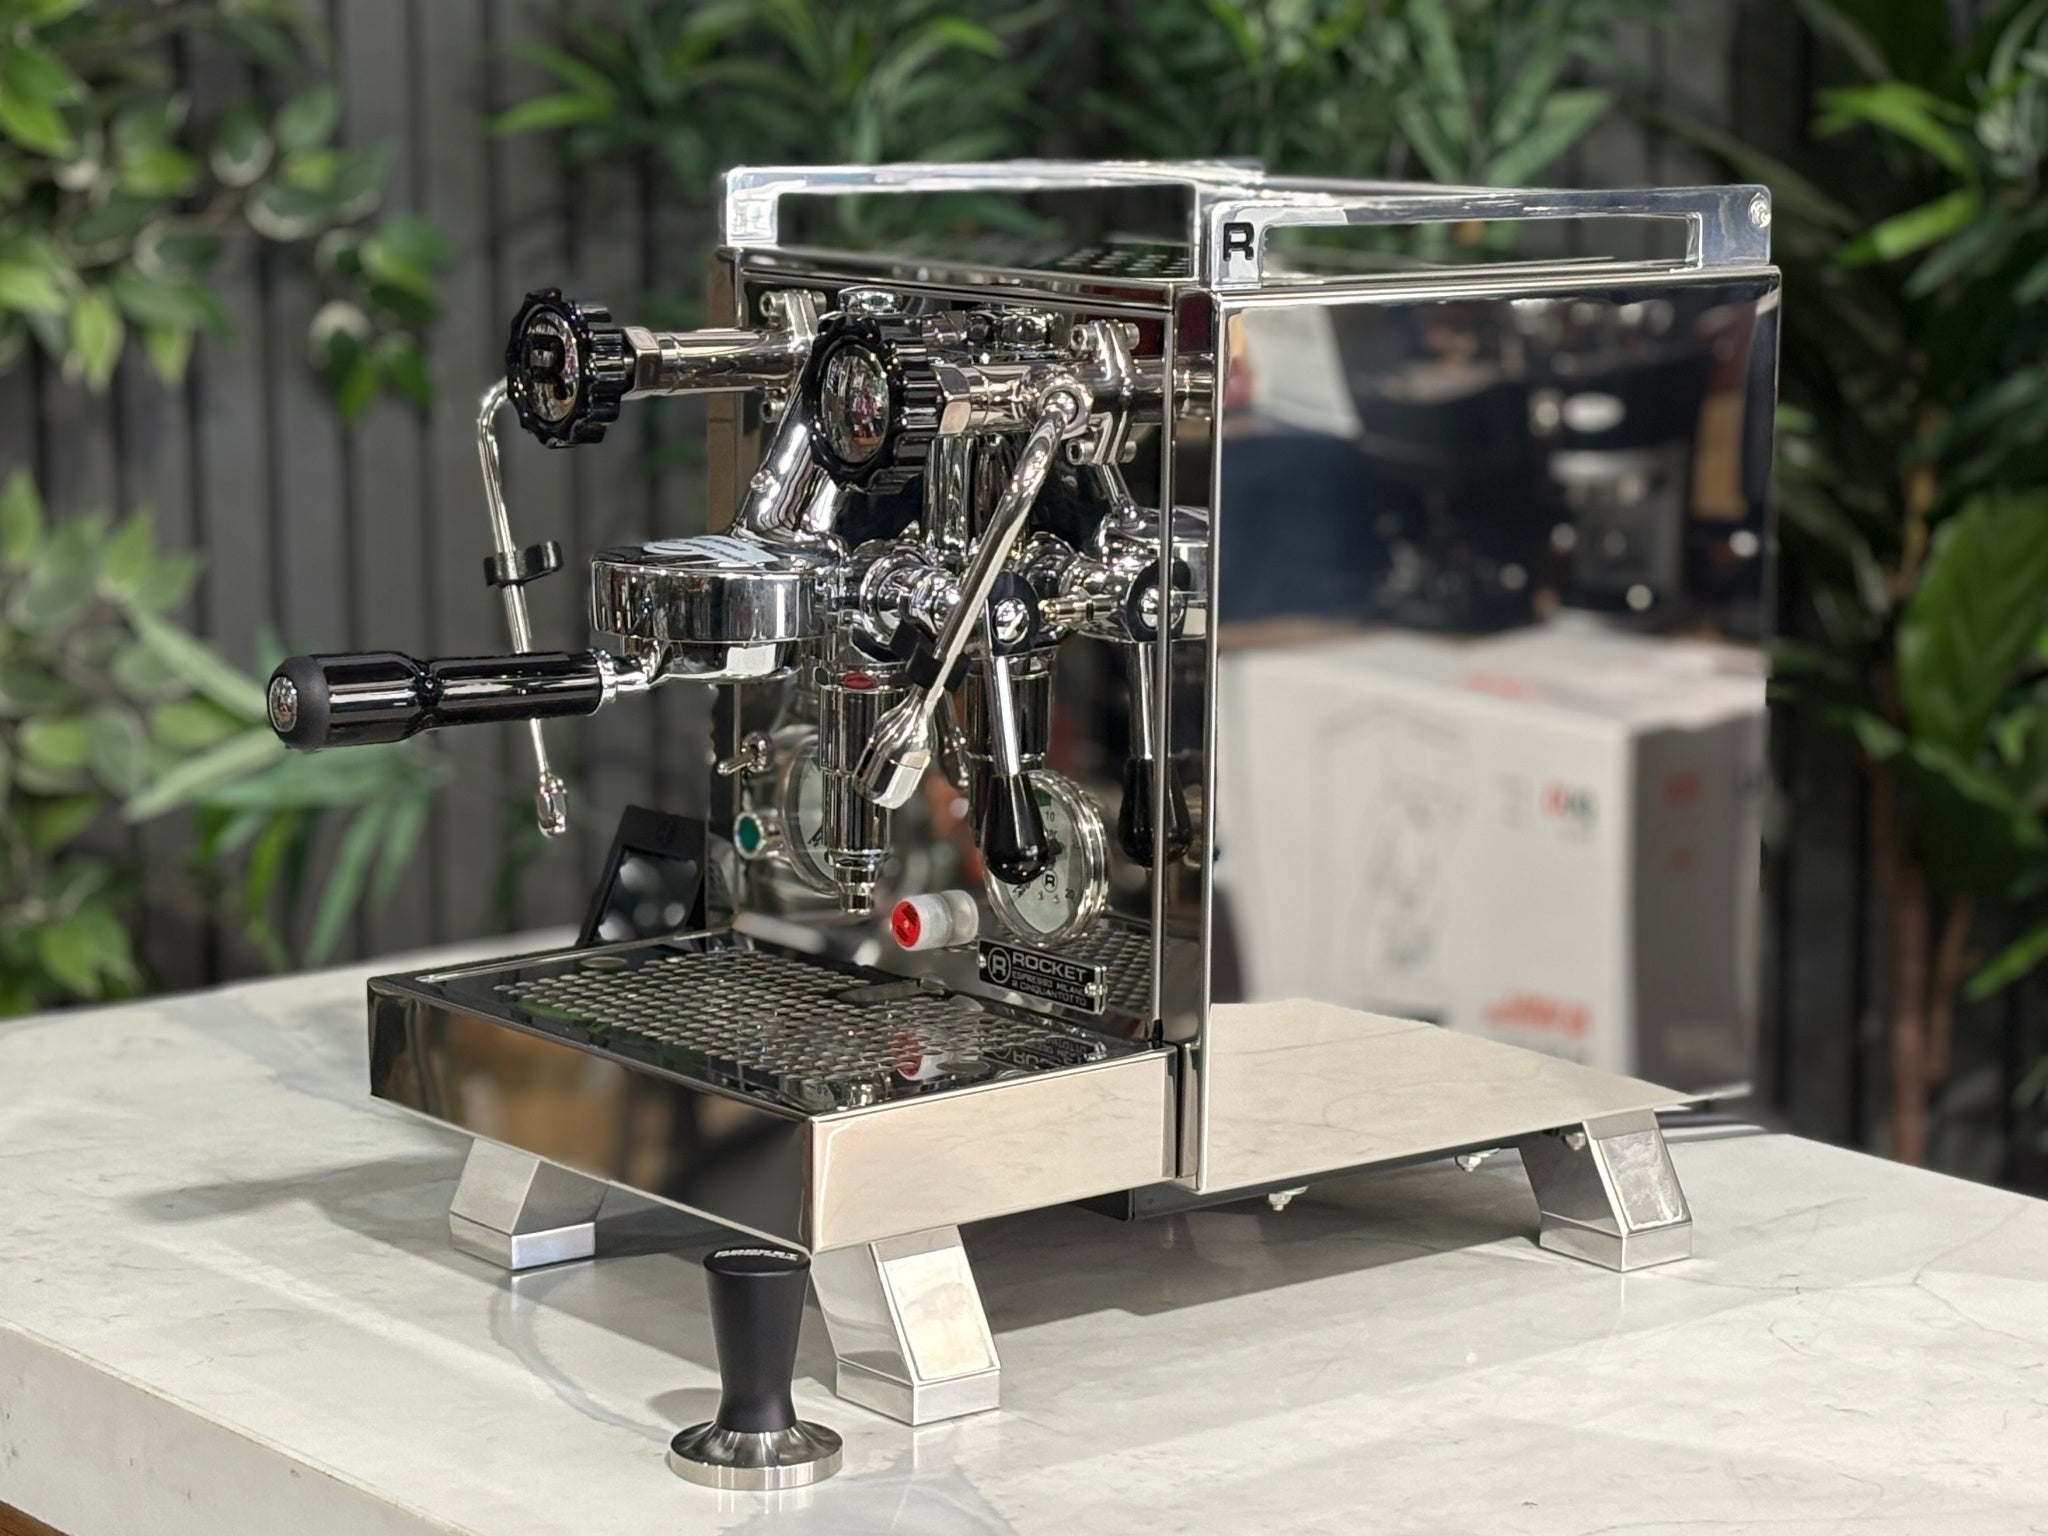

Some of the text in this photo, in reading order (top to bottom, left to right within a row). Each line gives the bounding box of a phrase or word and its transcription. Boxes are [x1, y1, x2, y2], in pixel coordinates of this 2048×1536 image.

[1223, 222, 1254, 261] R
[992, 954, 1006, 976] R
[1012, 951, 1087, 982] ROCKET
[1012, 970, 1053, 988] ESPRESSO
